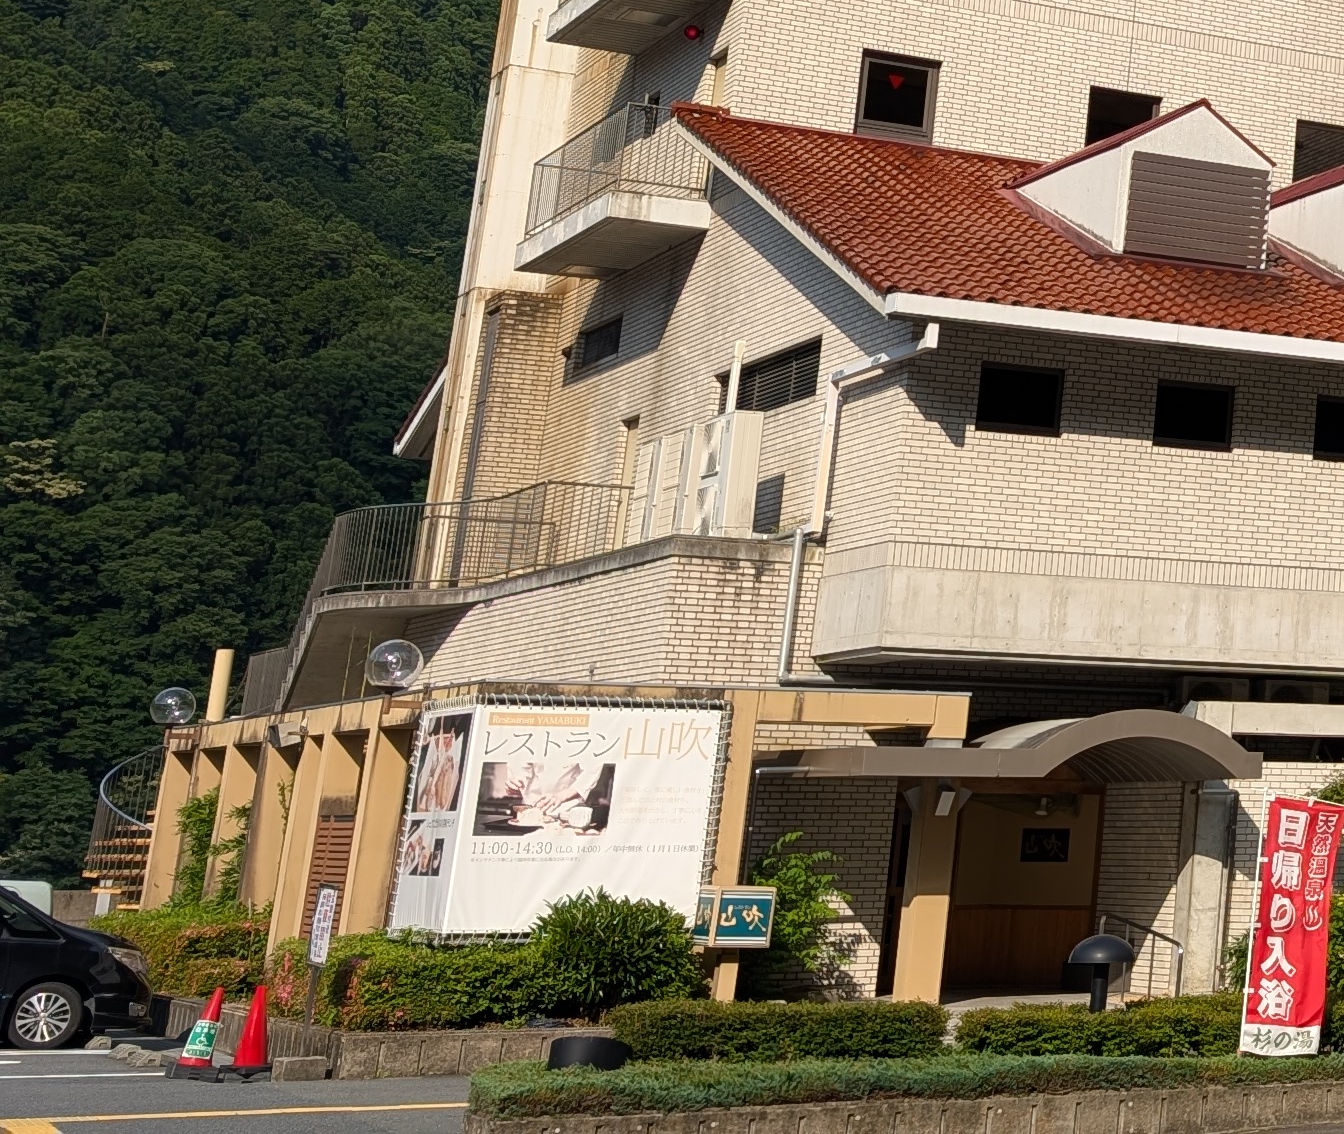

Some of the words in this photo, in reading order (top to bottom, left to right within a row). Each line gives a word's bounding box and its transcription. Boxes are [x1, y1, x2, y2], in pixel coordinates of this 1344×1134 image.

[492, 715, 534, 724] Restaurant
[537, 716, 586, 725] YAMABUKI
[472, 842, 552, 855] 11:00-14:30
[720, 905, 766, 932] 山吹
[1257, 809, 1310, 1021] 日帰り入浴
[1251, 1027, 1314, 1049] 杉の湯
